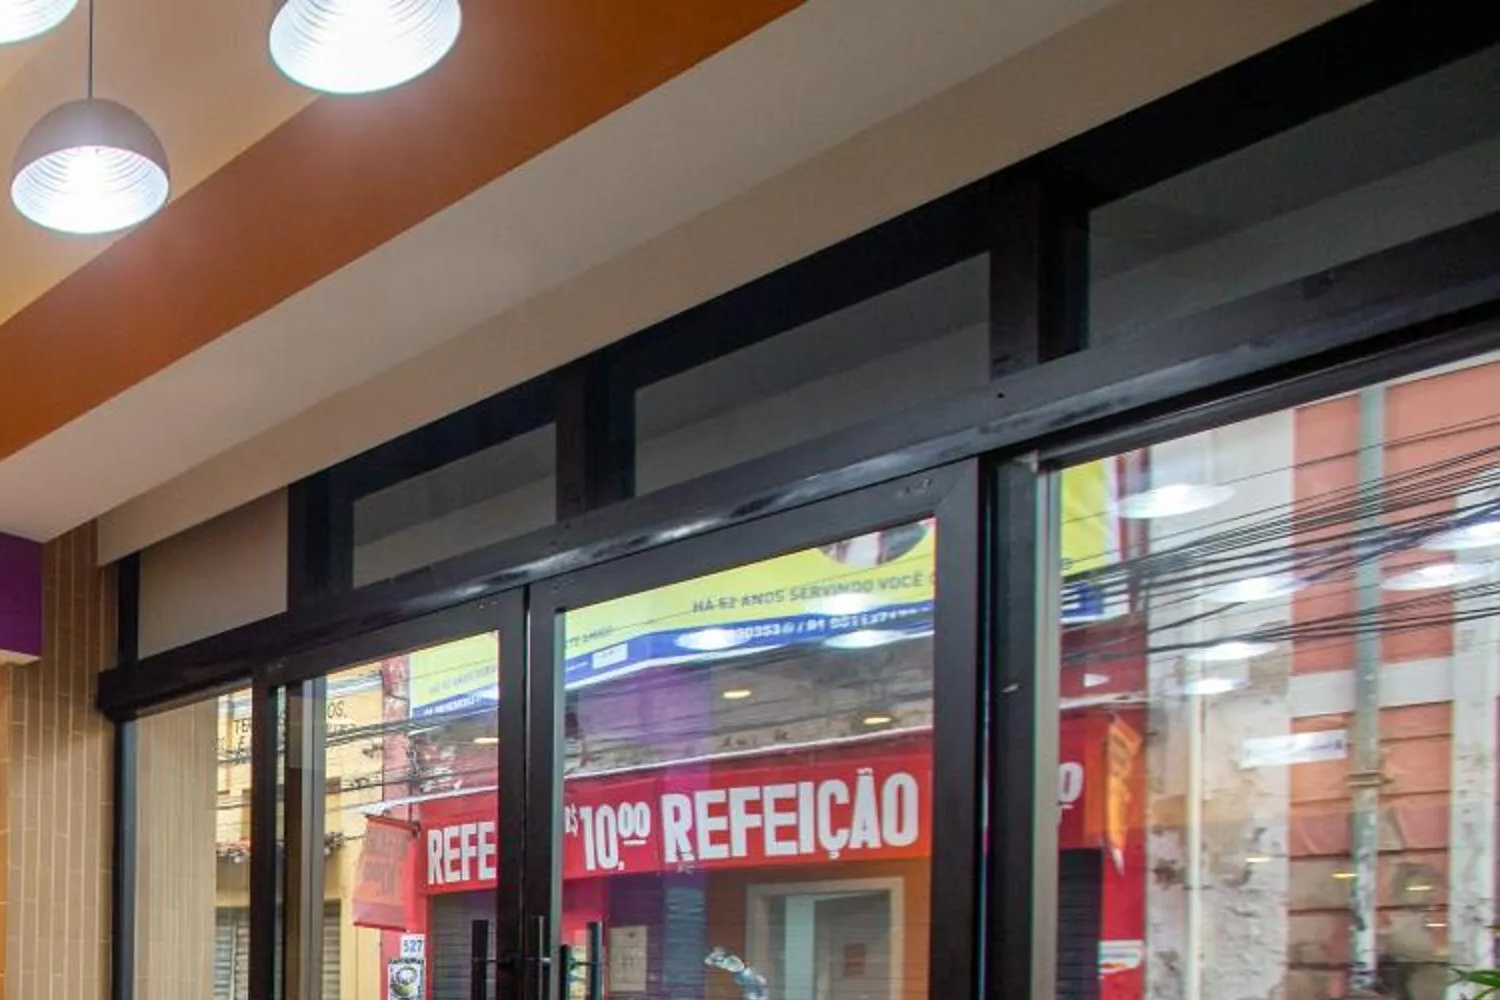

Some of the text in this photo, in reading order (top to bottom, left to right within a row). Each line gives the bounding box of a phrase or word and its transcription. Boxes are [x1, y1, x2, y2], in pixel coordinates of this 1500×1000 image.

[789, 578, 874, 602] SERVINDO
[661, 767, 919, 864] REFEIÇÃO
[427, 821, 497, 885] REFE
